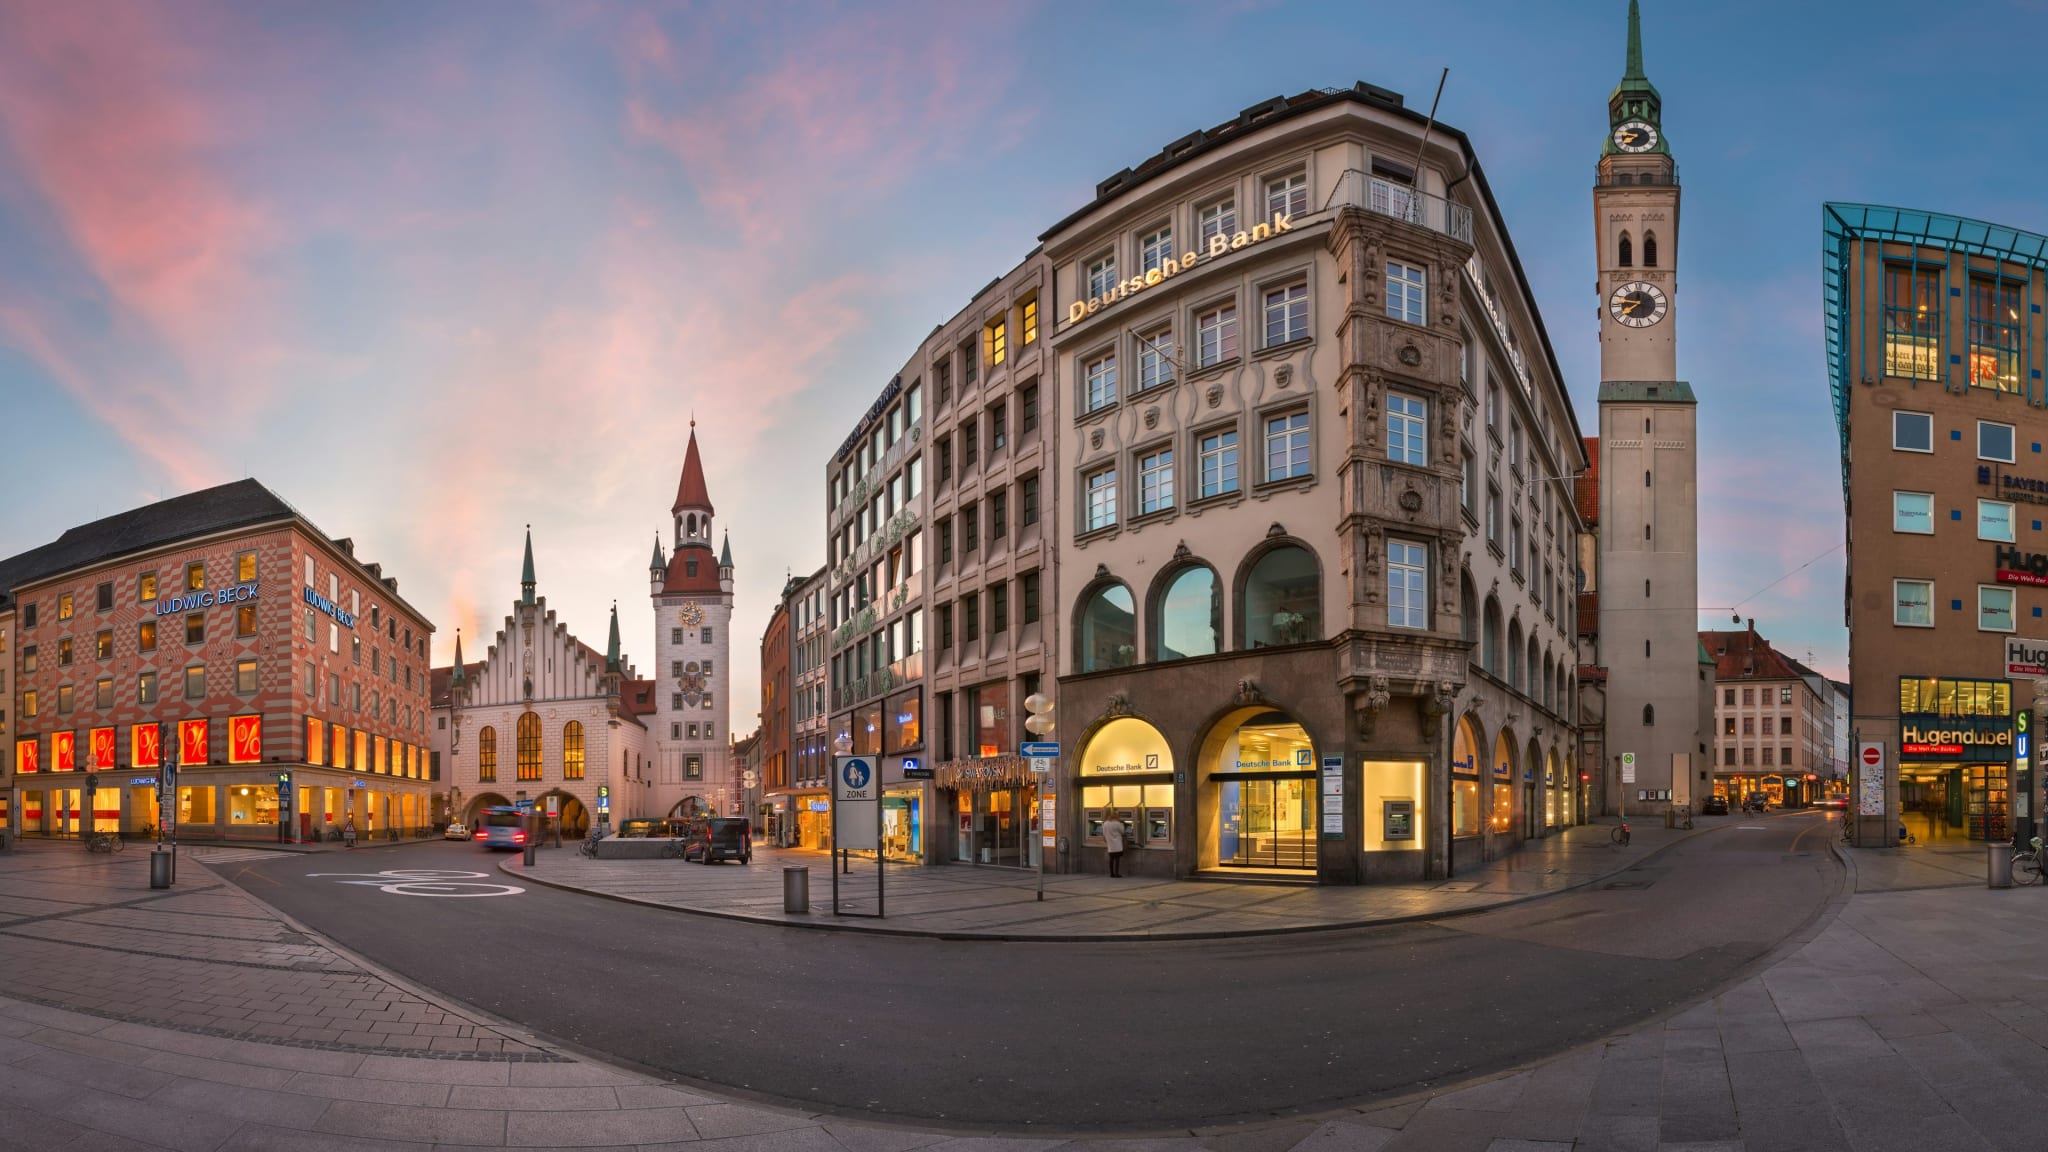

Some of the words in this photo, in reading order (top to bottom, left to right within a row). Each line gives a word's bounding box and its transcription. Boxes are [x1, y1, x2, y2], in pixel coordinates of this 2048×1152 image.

[1069, 250, 1199, 325] Deutsche
[1209, 211, 1294, 258] Bank
[1470, 257, 1514, 357] Deutsche
[1513, 350, 1532, 400] Bank
[2004, 475, 2048, 493] BAYER
[156, 593, 213, 615] LUDWIG
[218, 584, 259, 604] BECK
[304, 587, 334, 616] LUDWIG
[337, 607, 355, 629] BECK
[2018, 712, 2026, 732] S
[1903, 726, 2012, 746] Hugendubel
[2018, 737, 2026, 755] U
[965, 767, 1005, 778] SWAROVSKI
[1096, 764, 1125, 772] Deutsche
[1126, 763, 1142, 771] Bank
[1236, 760, 1270, 768] Deutsche
[601, 787, 608, 796] S
[846, 790, 867, 798] ZONE
